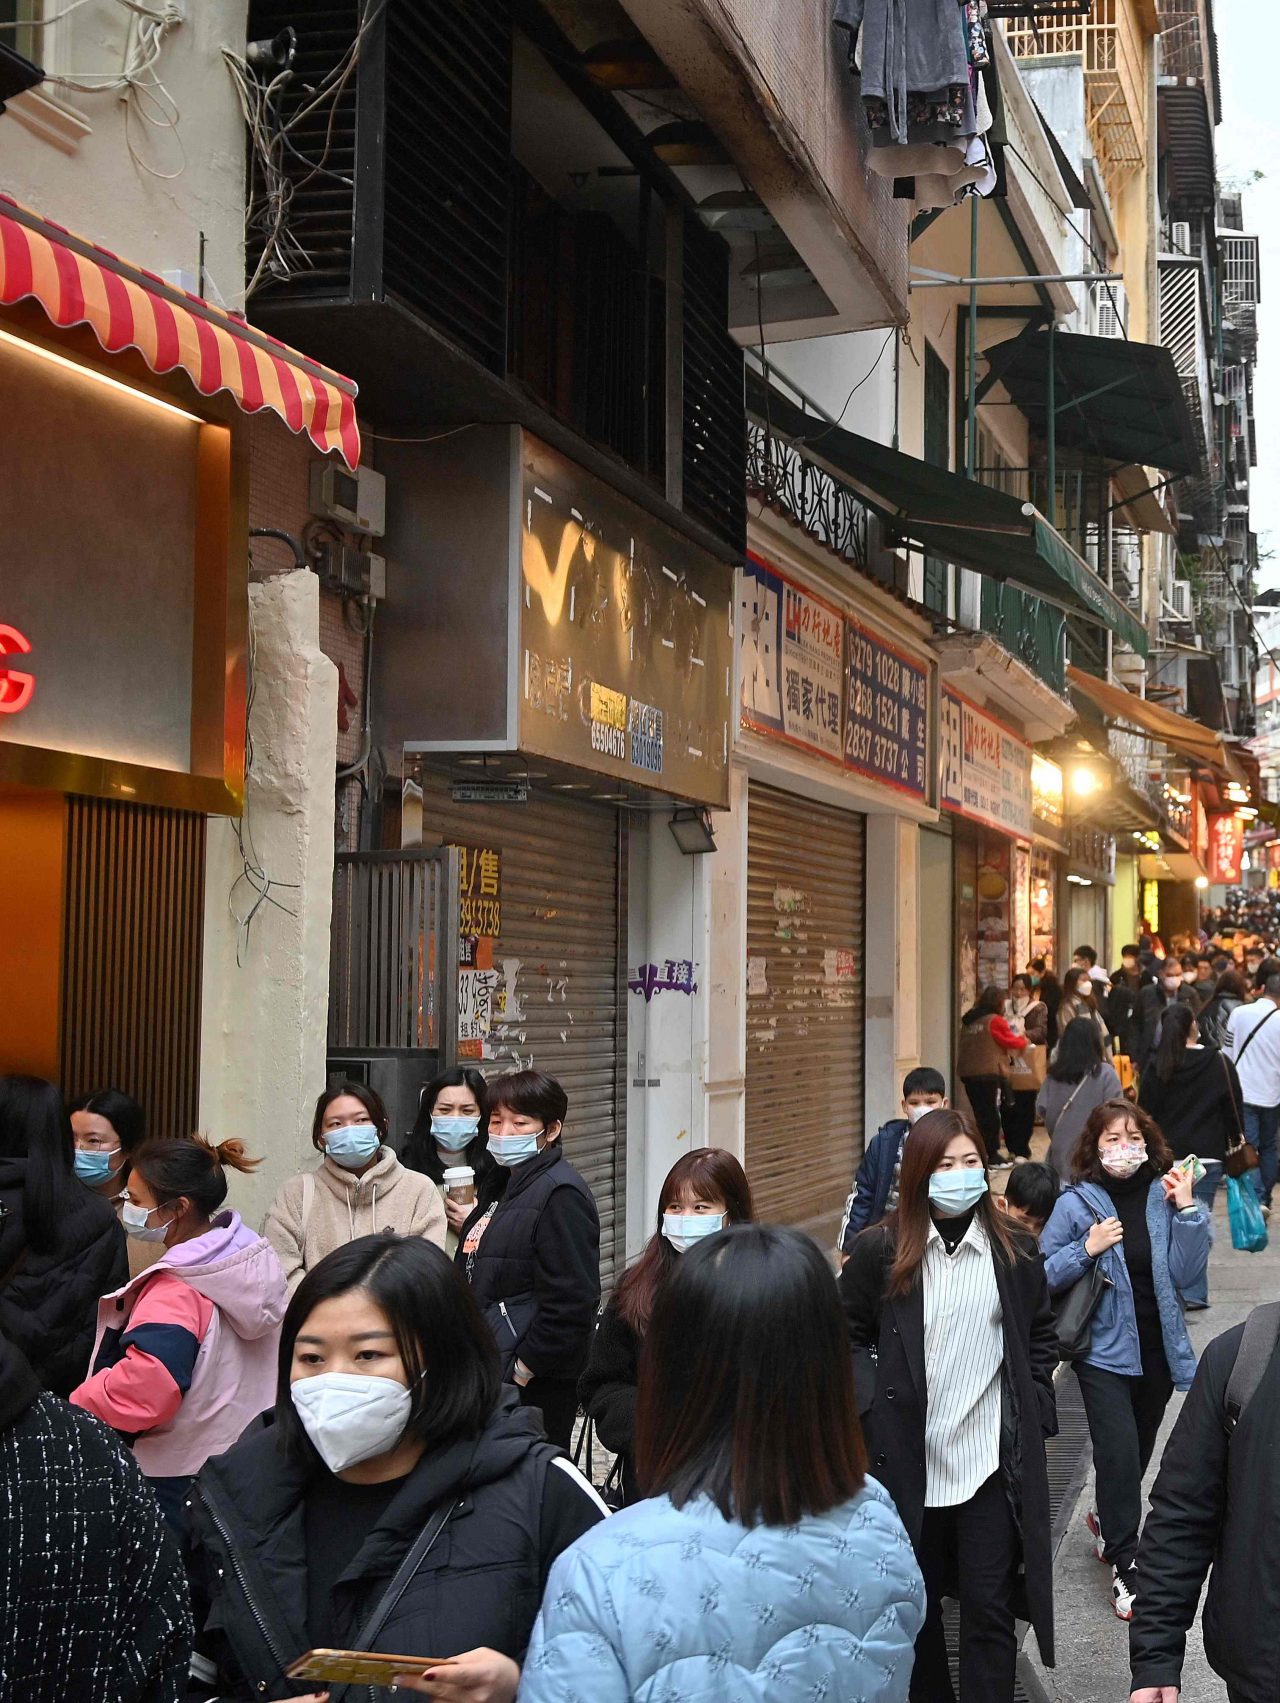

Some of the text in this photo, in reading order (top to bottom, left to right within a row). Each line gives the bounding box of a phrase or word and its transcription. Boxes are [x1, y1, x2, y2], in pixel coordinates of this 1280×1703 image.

[850, 632, 873, 678] 6279
[875, 650, 900, 694] 1028
[786, 666, 839, 736] 獨家代理
[875, 691, 898, 734] 1521
[846, 719, 872, 763] 2837
[874, 733, 899, 774] 3737
[459, 898, 500, 936] 3913738
